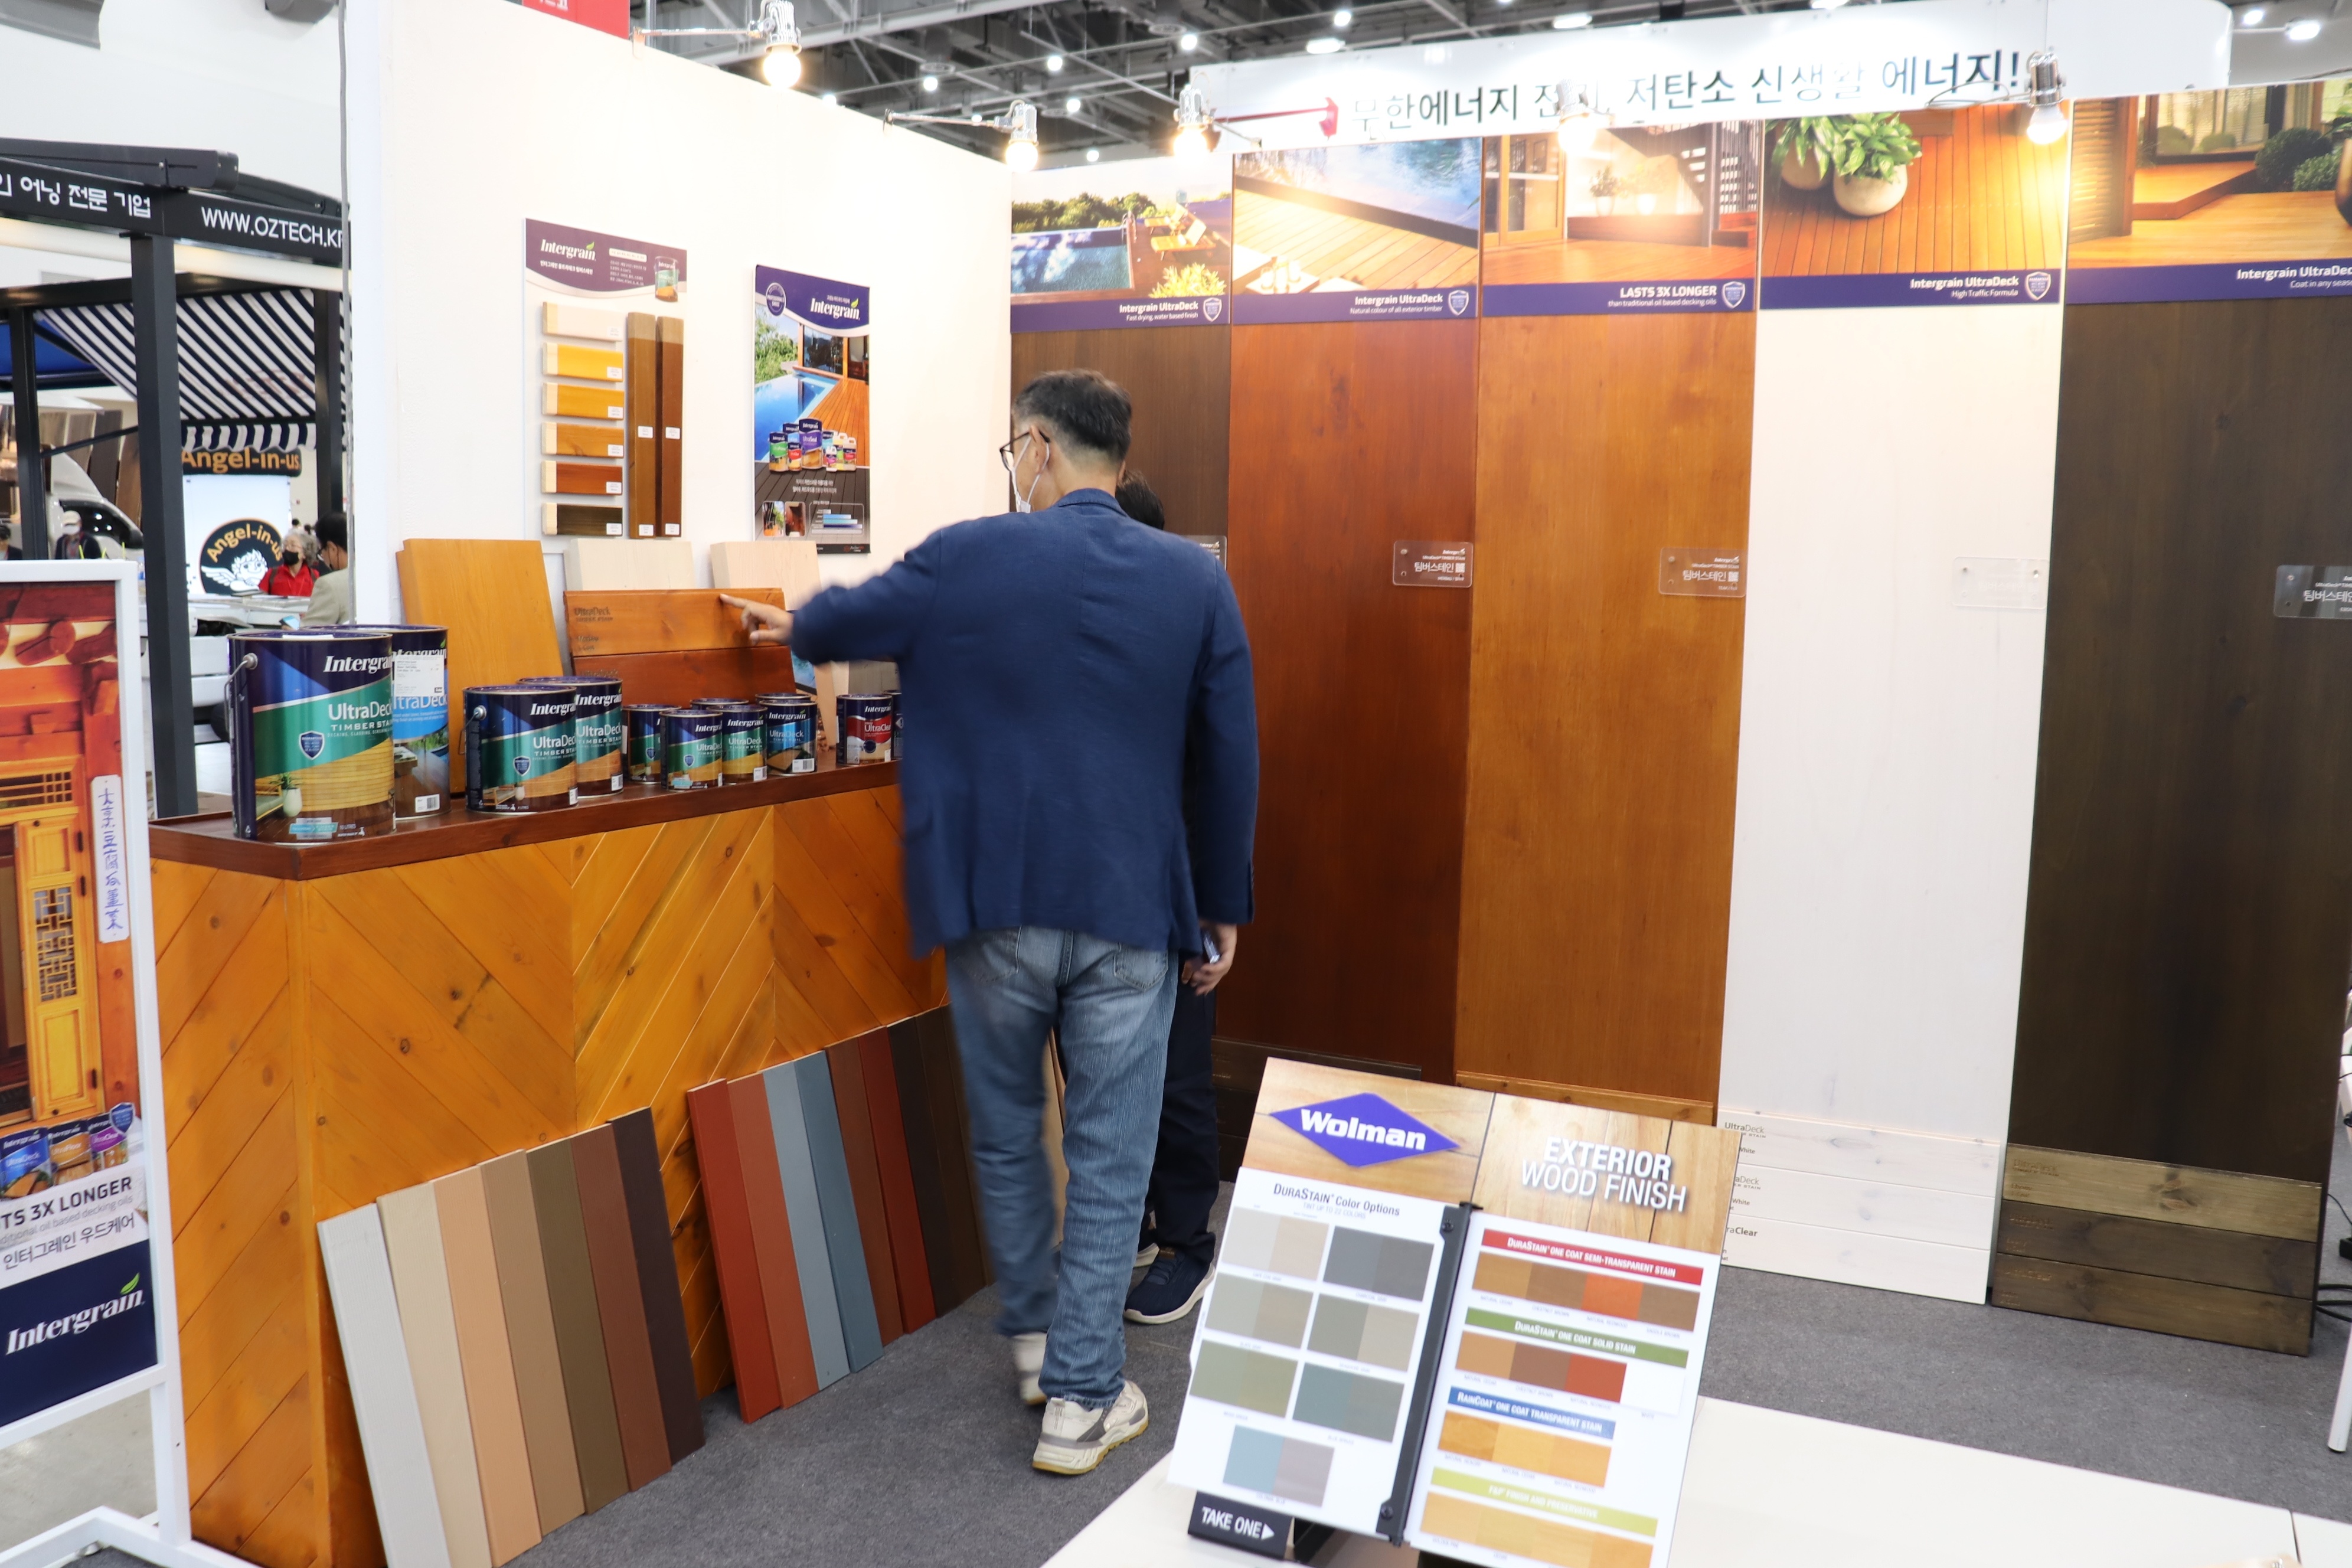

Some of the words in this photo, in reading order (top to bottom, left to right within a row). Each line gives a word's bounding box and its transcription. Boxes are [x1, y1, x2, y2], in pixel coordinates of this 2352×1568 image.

[1352, 84, 1518, 132] 무한에너지
[1626, 70, 1736, 112] 저탄소
[1882, 50, 2020, 96] 에너지!
[20, 175, 60, 205] 어닝
[68, 184, 107, 213] 전문
[114, 191, 151, 218] 기업
[541, 239, 596, 260] Intergrain
[2236, 267, 2297, 282] Intergrain
[2299, 265, 2352, 277] UltraDec
[1620, 286, 1655, 298] LASTS
[1657, 286, 1671, 298] 3X
[1672, 285, 1717, 296] LONGER
[1910, 277, 1963, 291] Intergrain
[1965, 276, 2019, 288] UltraDeck
[2290, 280, 2308, 289] Coat
[2317, 280, 2332, 289] any
[1355, 295, 1397, 306] Intergrain
[1399, 293, 1443, 304] UltraDeck
[1952, 290, 1967, 299] High
[1990, 289, 2018, 297] Formula
[810, 298, 860, 319] Intergrain
[1119, 303, 1158, 314] Intergrain
[1159, 301, 1198, 312] UltraDeck
[1681, 298, 1705, 307] decking
[181, 447, 300, 474] Angel-in-us
[1414, 561, 1453, 573] 팀버스테인
[1683, 570, 1726, 582] 팀버스테인
[727, 718, 764, 727] Intergrain
[769, 712, 806, 720] Intergrain
[331, 721, 375, 731] TIMBER
[769, 730, 804, 738] UltraDeck
[533, 734, 576, 750] UltraDec
[729, 737, 763, 746] UltraDeck
[1301, 1108, 1426, 1151] Wolman
[1724, 1122, 1765, 1134] UltraDeck
[1543, 1136, 1671, 1181] EXTERIOR
[1521, 1159, 1597, 1197] WOOD
[1604, 1174, 1687, 1213] FINISH
[1735, 1175, 1760, 1185] aDeck
[1, 1209, 25, 1229] TS
[31, 1200, 54, 1221] 3X
[60, 1176, 132, 1211] LONGER
[1335, 1195, 1361, 1210] Color
[1363, 1200, 1400, 1217] Options
[53, 1211, 80, 1228] based
[82, 1201, 116, 1219] decking
[118, 1194, 133, 1207] oils
[1343, 1209, 1366, 1220] COLORS
[1726, 1227, 1758, 1237] raClear
[4, 1231, 77, 1270] 인터그레인
[80, 1212, 135, 1244] 우드케어
[1550, 1247, 1564, 1257] ONE
[1565, 1249, 1583, 1260] COAT
[1584, 1253, 1654, 1273] SEMI-TRANSPARENT
[1654, 1266, 1676, 1278] STAIN
[5, 1289, 143, 1355] Intergrain
[1558, 1331, 1573, 1341] ONE
[1573, 1333, 1592, 1345] COAT
[1593, 1337, 1614, 1349] SOLID
[1615, 1341, 1636, 1354] STAIN
[1496, 1402, 1510, 1412] ONE
[1511, 1404, 1530, 1416] COAT
[1531, 1409, 1580, 1428] TRANSPARENT
[1581, 1420, 1602, 1433] STAIN
[1202, 1506, 1233, 1531] TAKE
[1234, 1517, 1263, 1538] ONE
